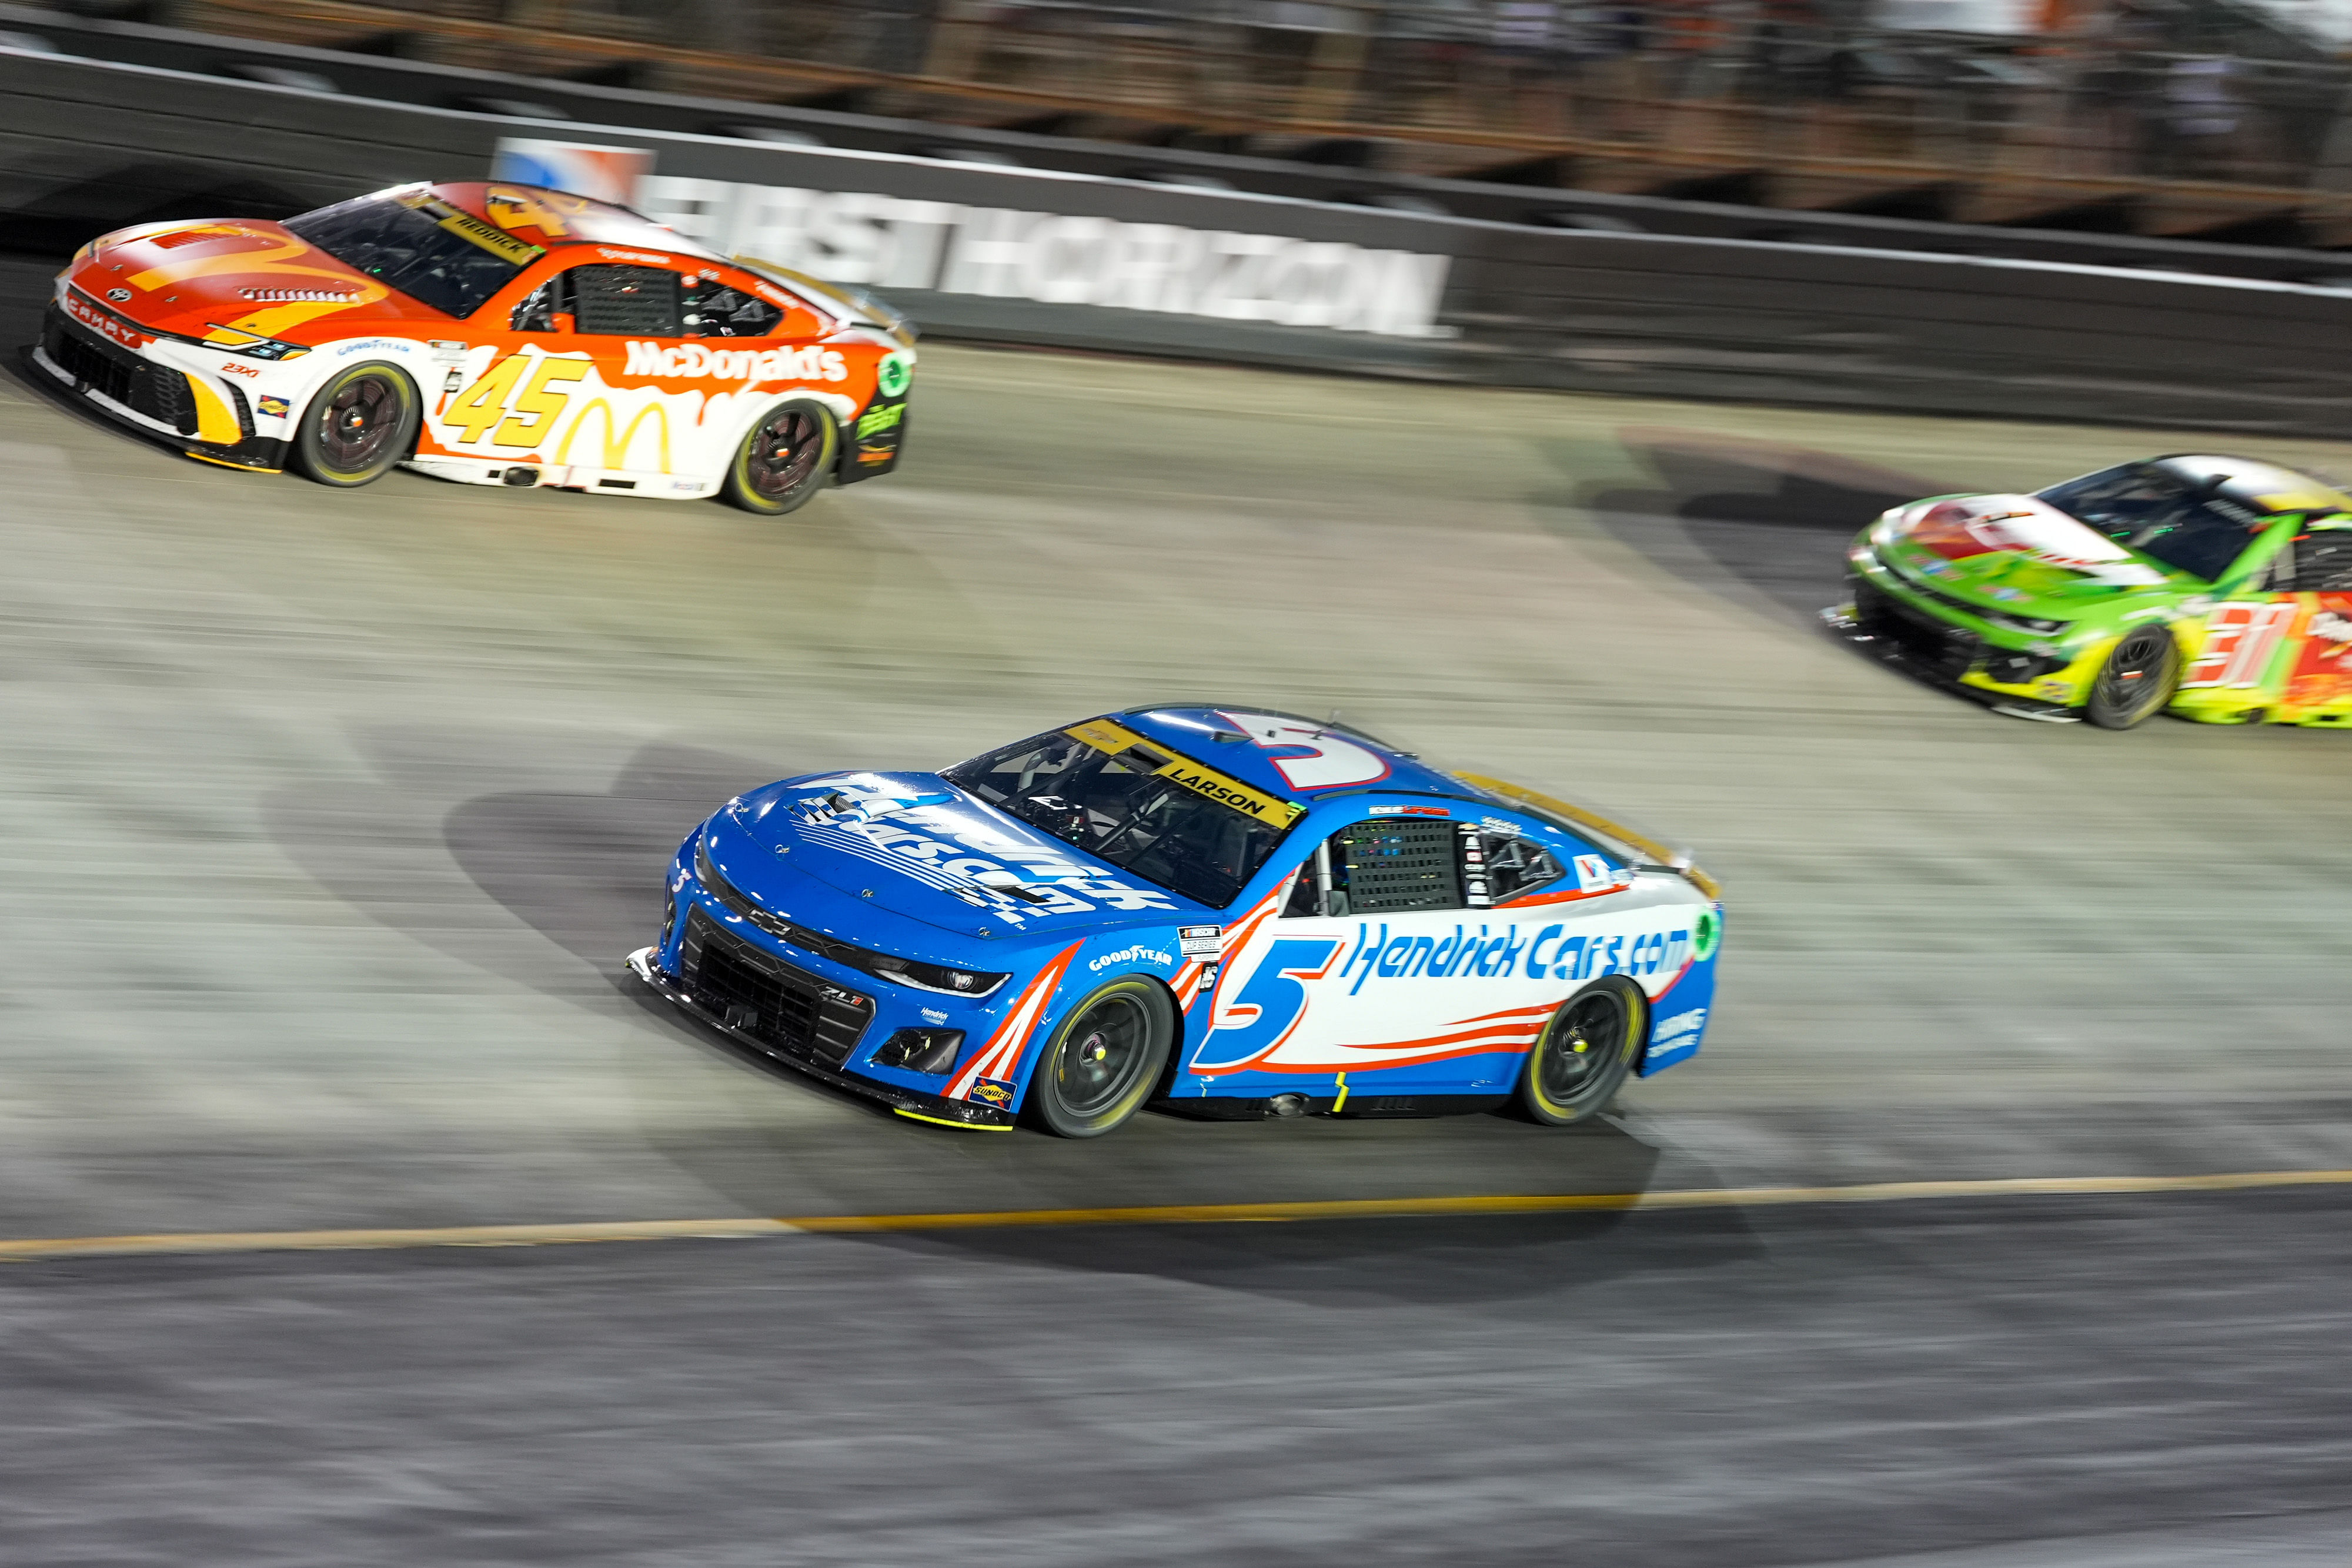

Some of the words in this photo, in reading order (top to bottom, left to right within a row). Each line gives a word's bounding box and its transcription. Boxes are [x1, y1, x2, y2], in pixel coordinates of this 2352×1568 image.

[637, 175, 968, 289] FIRST
[937, 206, 1454, 334] HORIZON
[68, 298, 136, 342] CAMRY
[443, 353, 595, 448] 45
[1168, 768, 1266, 815] LARSON
[1088, 945, 1173, 971] GOODYEAR
[920, 1007, 949, 1020] Hendrick
[1189, 936, 1347, 1075] 5
[974, 1086, 1011, 1100] SUNOCO
